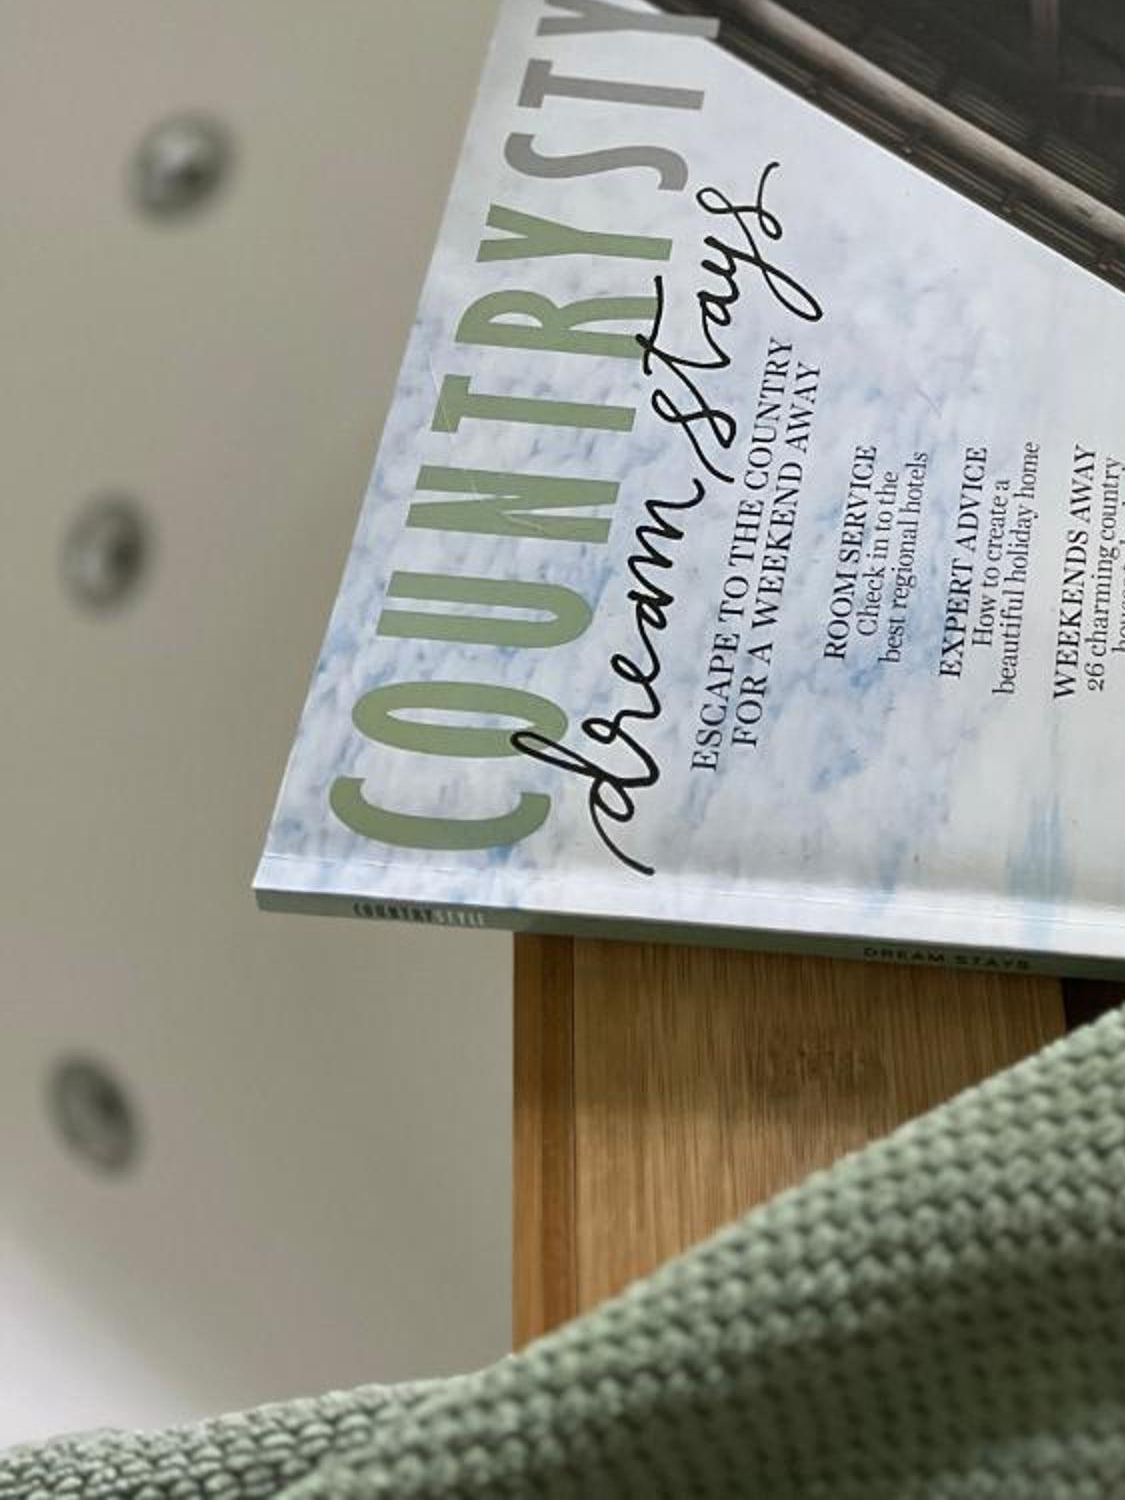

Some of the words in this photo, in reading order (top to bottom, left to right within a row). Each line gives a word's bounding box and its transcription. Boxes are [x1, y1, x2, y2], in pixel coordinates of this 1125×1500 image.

[743, 336, 793, 491] COUNTRY
[785, 360, 821, 454] AWAY
[839, 445, 877, 565] SERVICE
[874, 470, 899, 507] the
[899, 451, 928, 514] hotels
[955, 447, 987, 552] ADVICE
[995, 479, 1010, 492] a
[1013, 441, 1040, 499] home
[1070, 443, 1096, 524] AWAY
[510, 478, 704, 876] dream
[635, 161, 822, 483] stays
[728, 499, 764, 567] THE
[751, 461, 803, 629] WEEKEND
[866, 537, 889, 560] in
[874, 510, 894, 532] to
[987, 494, 1009, 562] create
[1004, 505, 1038, 584] holiday
[718, 575, 750, 623] TO
[856, 565, 885, 637] Check
[891, 520, 918, 610] regional
[981, 566, 1000, 589] to
[823, 569, 858, 660] ROOM
[938, 558, 973, 678] EXPERT
[972, 594, 998, 647] How
[1053, 529, 1089, 699] WEEKENDS
[1084, 545, 1120, 658] charming
[747, 642, 773, 666] A
[877, 617, 906, 664] best
[992, 589, 1025, 695] beautiful
[690, 632, 740, 772] ESCAPE
[731, 675, 768, 748] FOR
[1084, 662, 1105, 692] 26
[863, 947, 945, 964] DREAM
[954, 955, 1029, 971] STAYS
